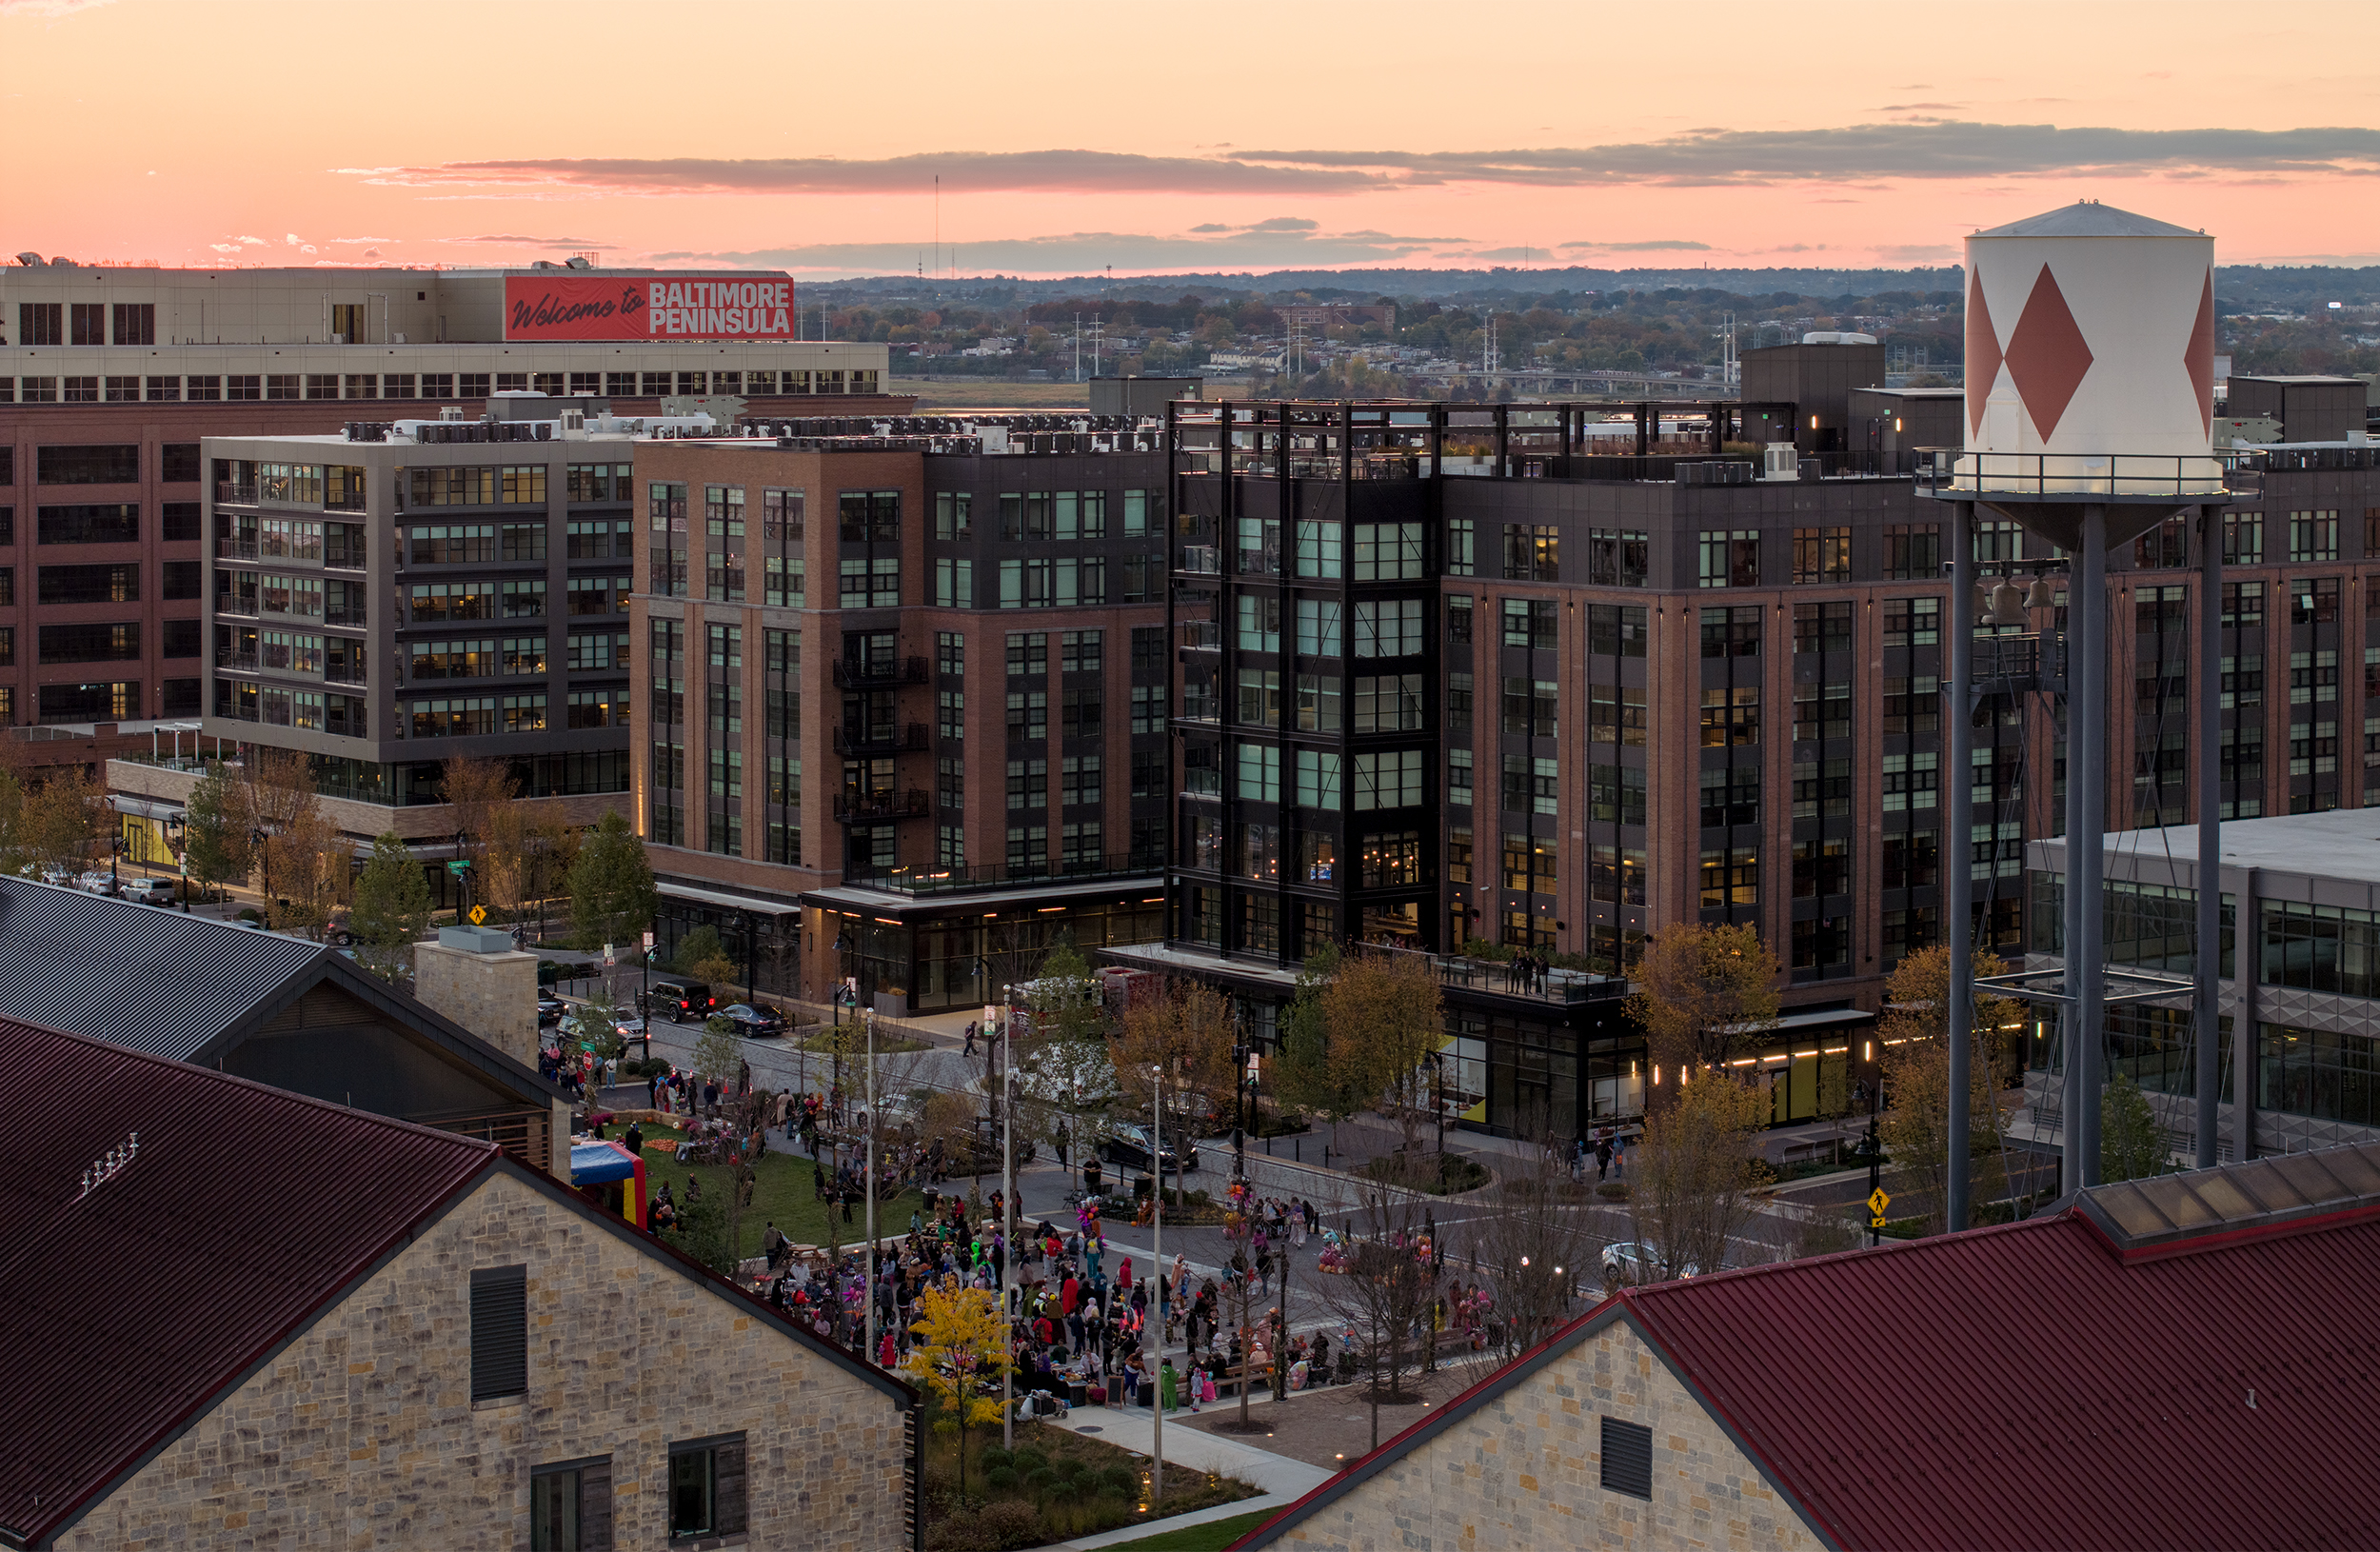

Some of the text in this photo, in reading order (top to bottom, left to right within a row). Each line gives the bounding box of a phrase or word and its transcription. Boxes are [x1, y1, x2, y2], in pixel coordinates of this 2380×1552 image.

[512, 286, 645, 329] Welcome to
[649, 283, 789, 308] BALTIMORE
[649, 308, 790, 333] PENINSULA
